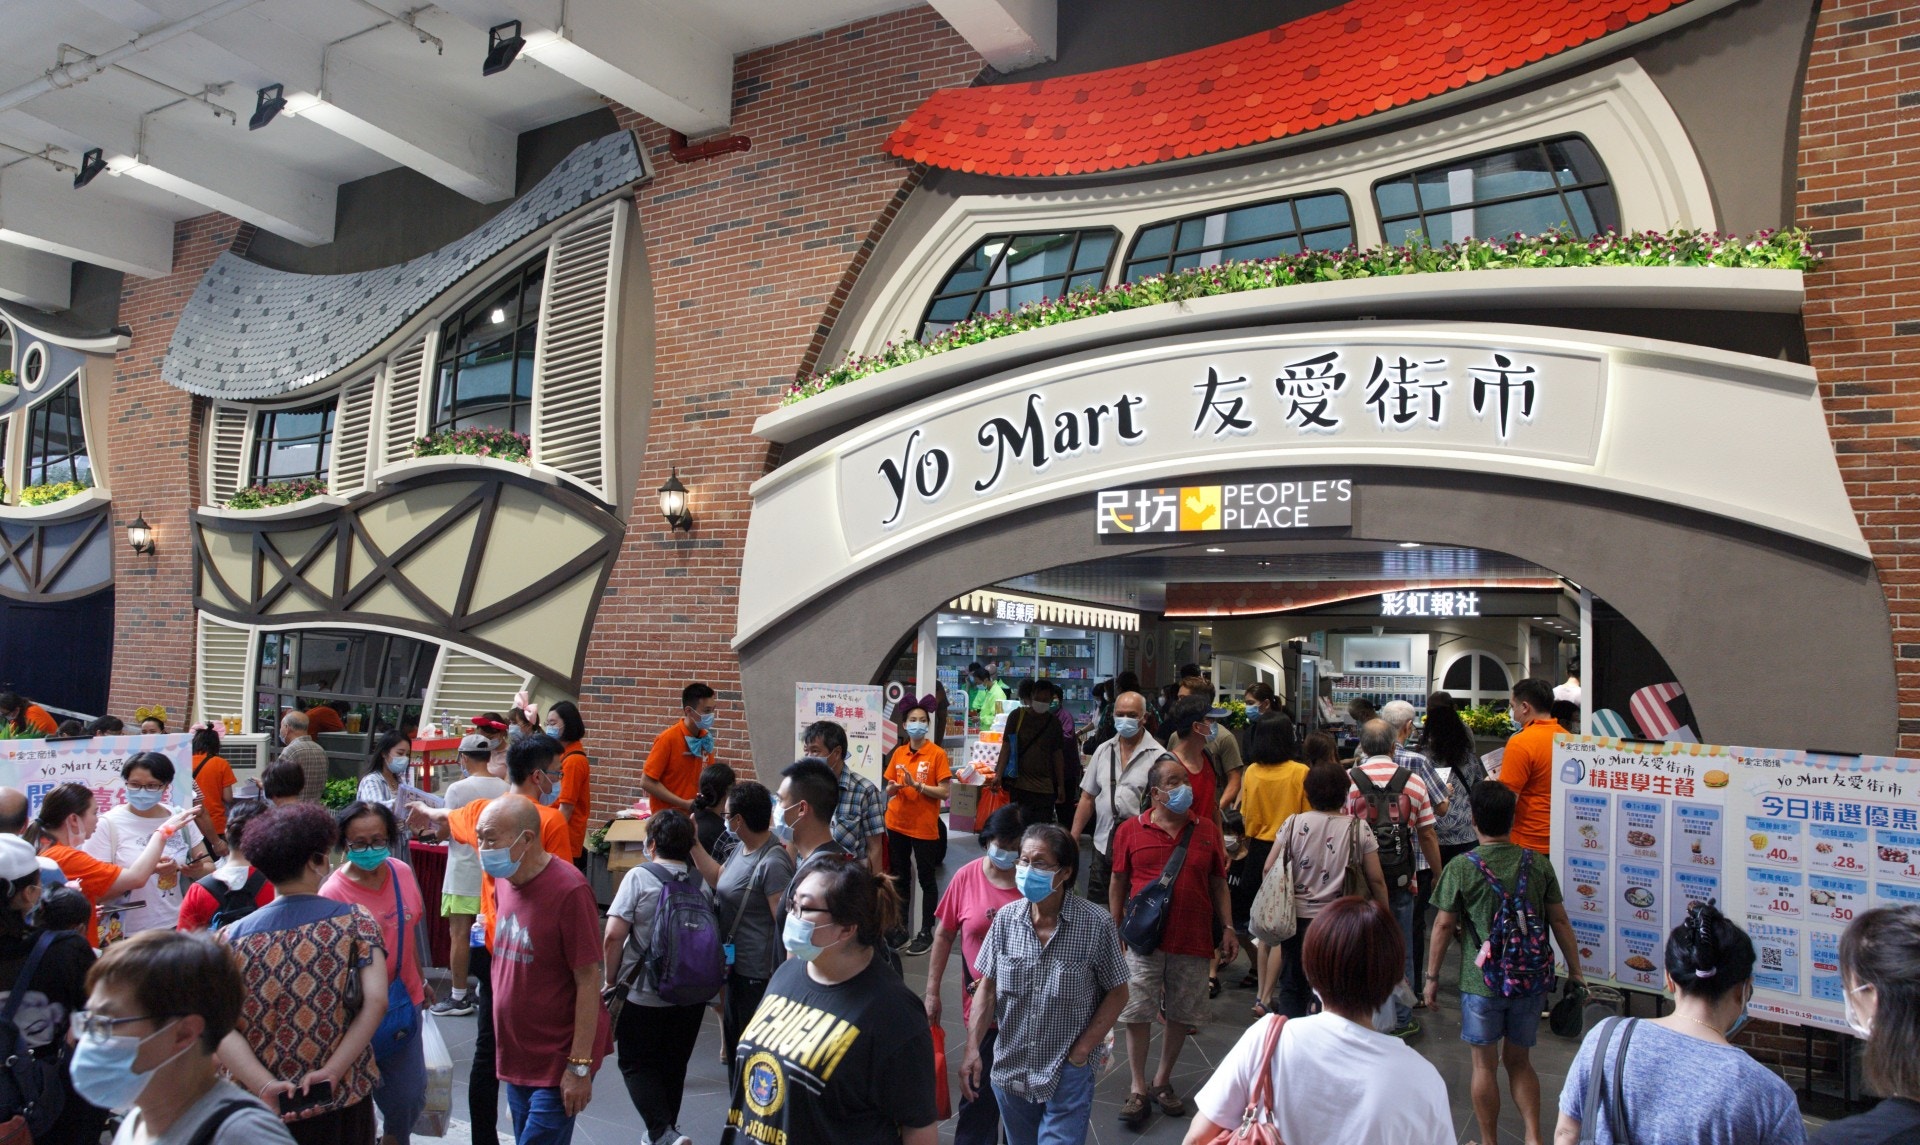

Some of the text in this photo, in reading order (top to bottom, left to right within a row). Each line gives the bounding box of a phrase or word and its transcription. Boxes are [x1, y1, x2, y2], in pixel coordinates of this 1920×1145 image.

[974, 393, 1144, 492] Mart
[1193, 350, 1536, 439] 友愛街市
[1223, 479, 1352, 506] PEOPLE'S
[1097, 489, 1177, 534] 民坊
[1223, 506, 1310, 530] PLACE
[1382, 591, 1480, 616] 彩虹報社
[60, 760, 92, 776] Mart
[95, 758, 124, 772] 友愛
[1608, 753, 1636, 767] Mart
[1639, 754, 1696, 778] 友愛街市
[1588, 768, 1696, 798] 精選學生餐
[1796, 773, 1829, 787] Mart
[1832, 773, 1903, 799] 友愛街市
[1761, 796, 1918, 831] 今日精選優惠
